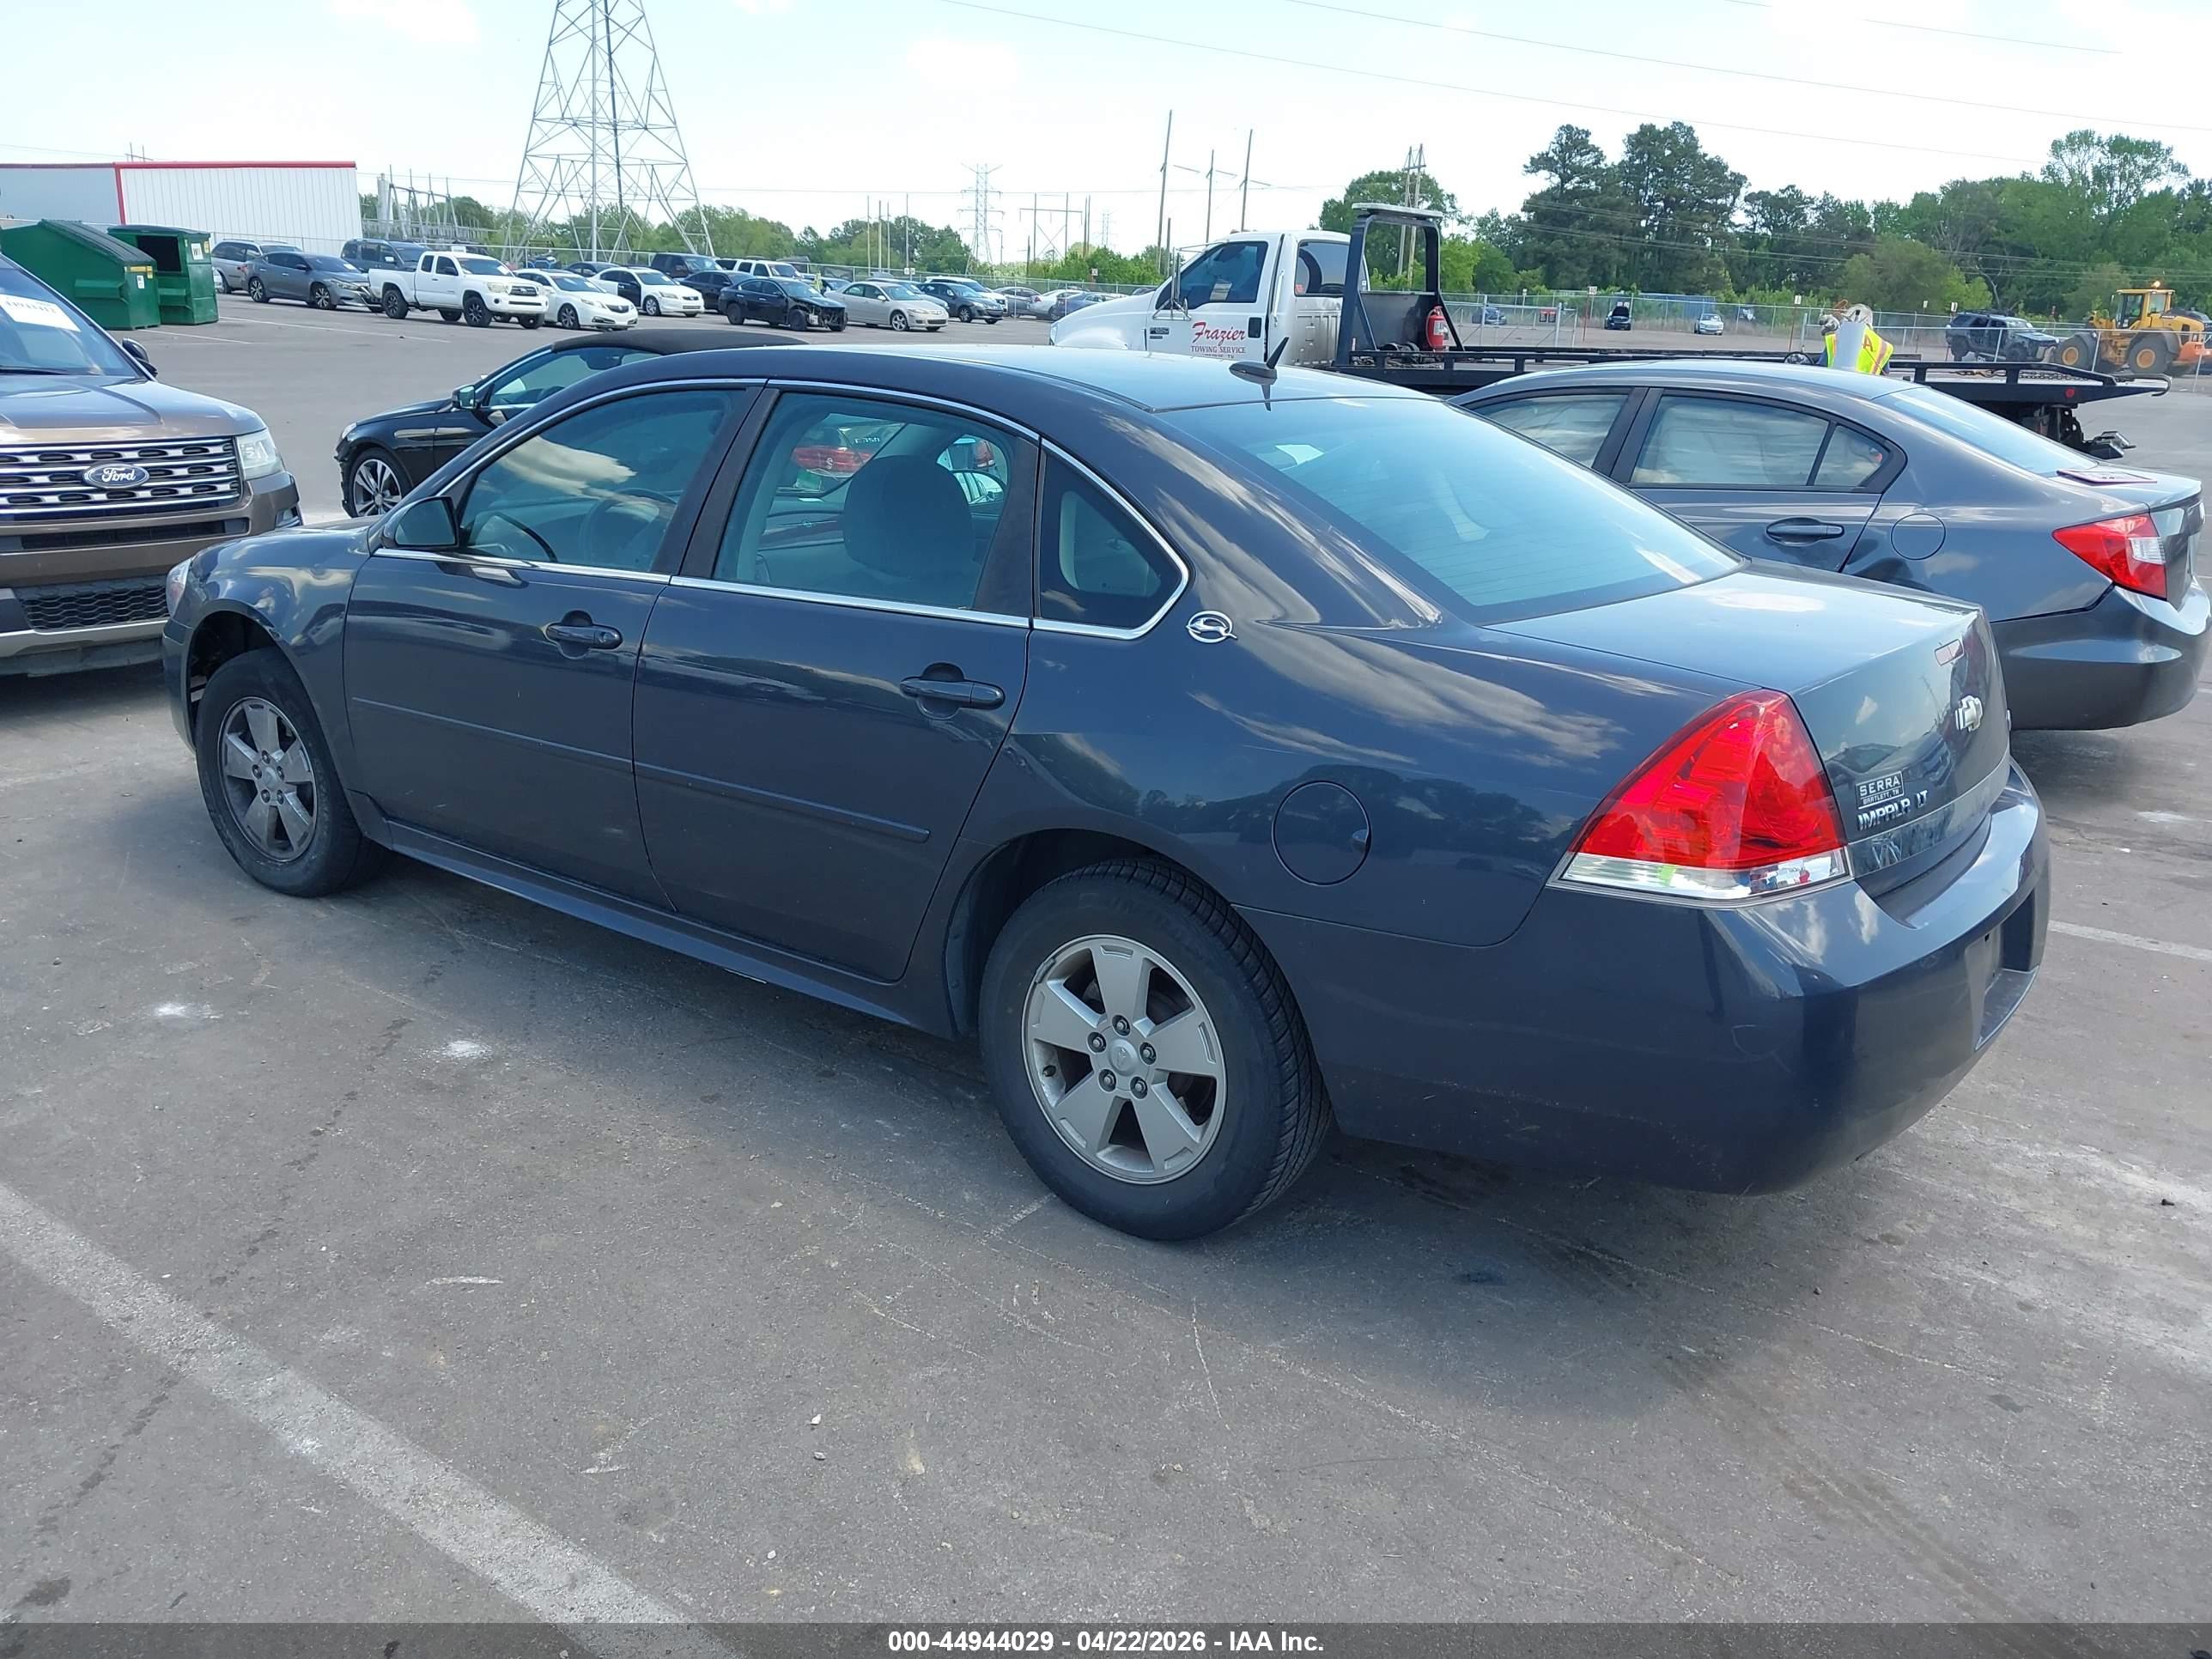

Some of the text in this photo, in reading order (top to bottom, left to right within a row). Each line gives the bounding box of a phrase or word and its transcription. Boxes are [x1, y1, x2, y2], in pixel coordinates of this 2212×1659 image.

[1192, 322, 1246, 346] Frazier
[101, 467, 137, 483] Ford
[1859, 775, 1900, 797] SERRA
[1857, 790, 1928, 830] IMPALA LT
